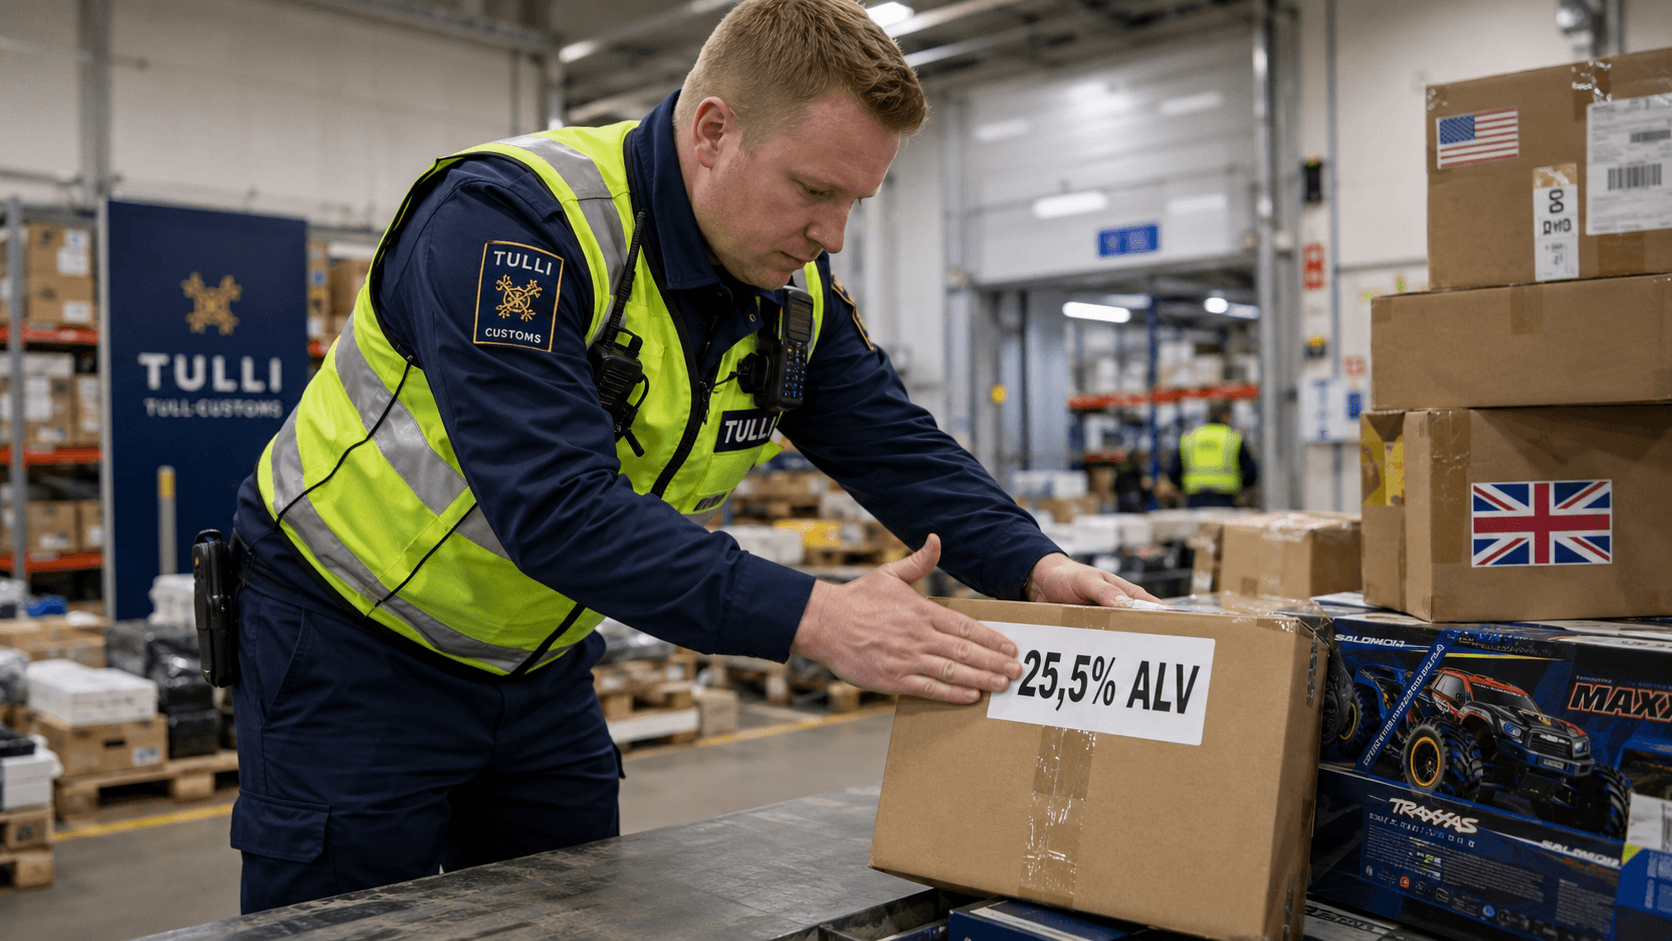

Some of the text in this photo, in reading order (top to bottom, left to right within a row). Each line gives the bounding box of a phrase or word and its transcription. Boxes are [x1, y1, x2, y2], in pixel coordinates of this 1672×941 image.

[493, 250, 552, 276] TULLI
[485, 327, 542, 344] CUSTOMS
[137, 352, 283, 394] TULLI
[724, 416, 777, 444] TULLI
[1017, 649, 1201, 714] 25,5% ALV
[1389, 797, 1480, 834] TRAXXAS
